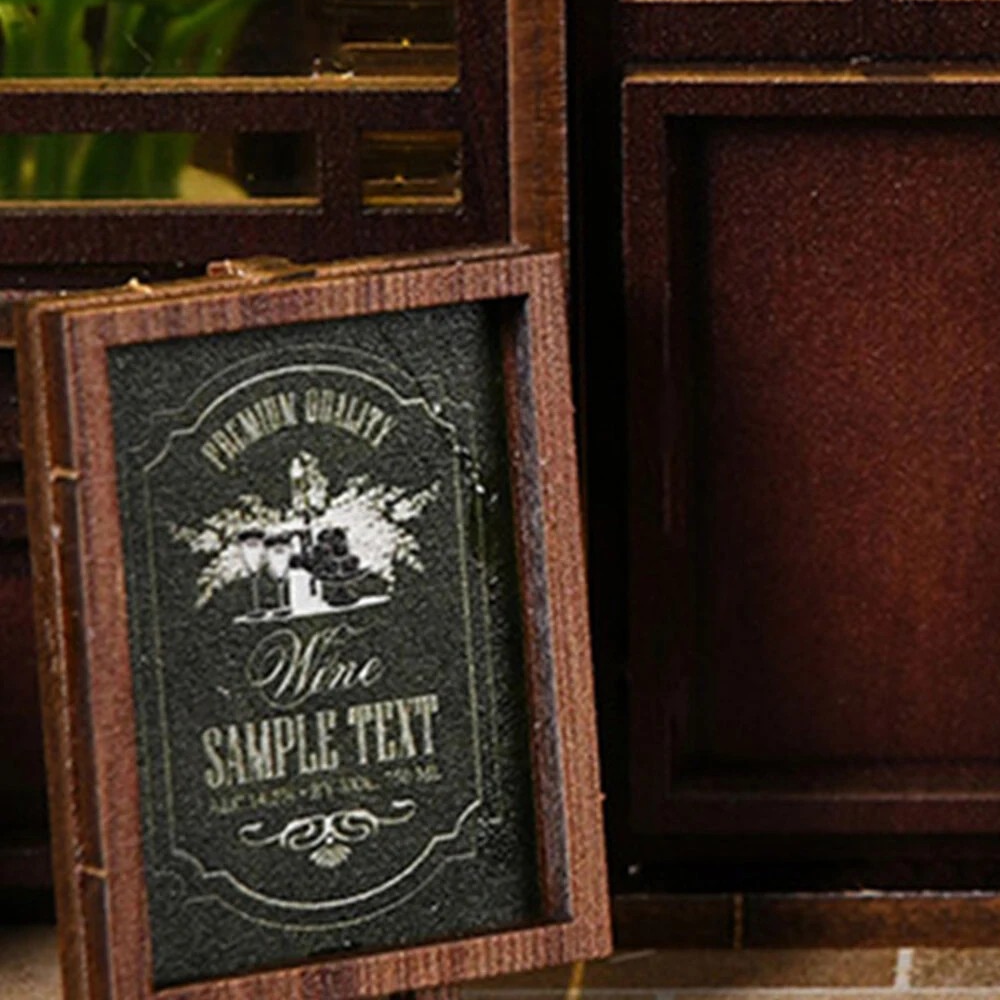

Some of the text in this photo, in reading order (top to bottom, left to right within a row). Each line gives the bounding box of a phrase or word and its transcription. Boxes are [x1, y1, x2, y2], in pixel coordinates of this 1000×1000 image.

[201, 387, 398, 471] PREMIUM QUALITY
[245, 622, 386, 709] Wine
[201, 709, 340, 789] SAMPLE
[347, 694, 439, 765] TEXT
